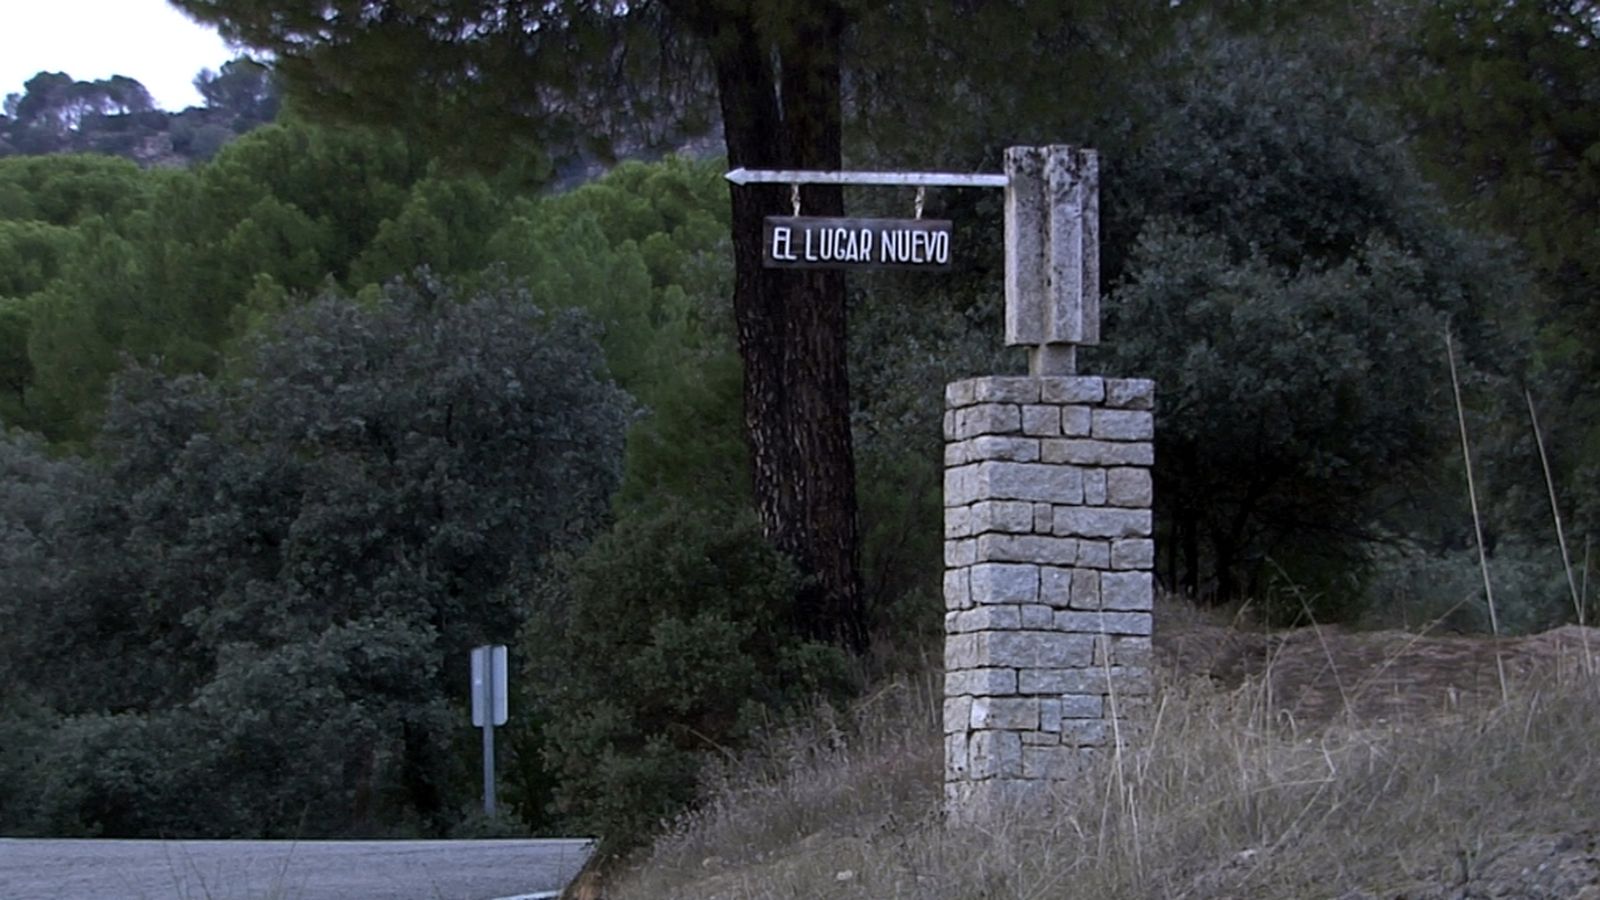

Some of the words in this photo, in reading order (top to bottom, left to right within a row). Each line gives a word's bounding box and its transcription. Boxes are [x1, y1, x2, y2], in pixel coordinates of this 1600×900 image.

[772, 227, 797, 260] EL
[805, 227, 872, 262] LUGAR
[880, 229, 949, 263] NUEVO
